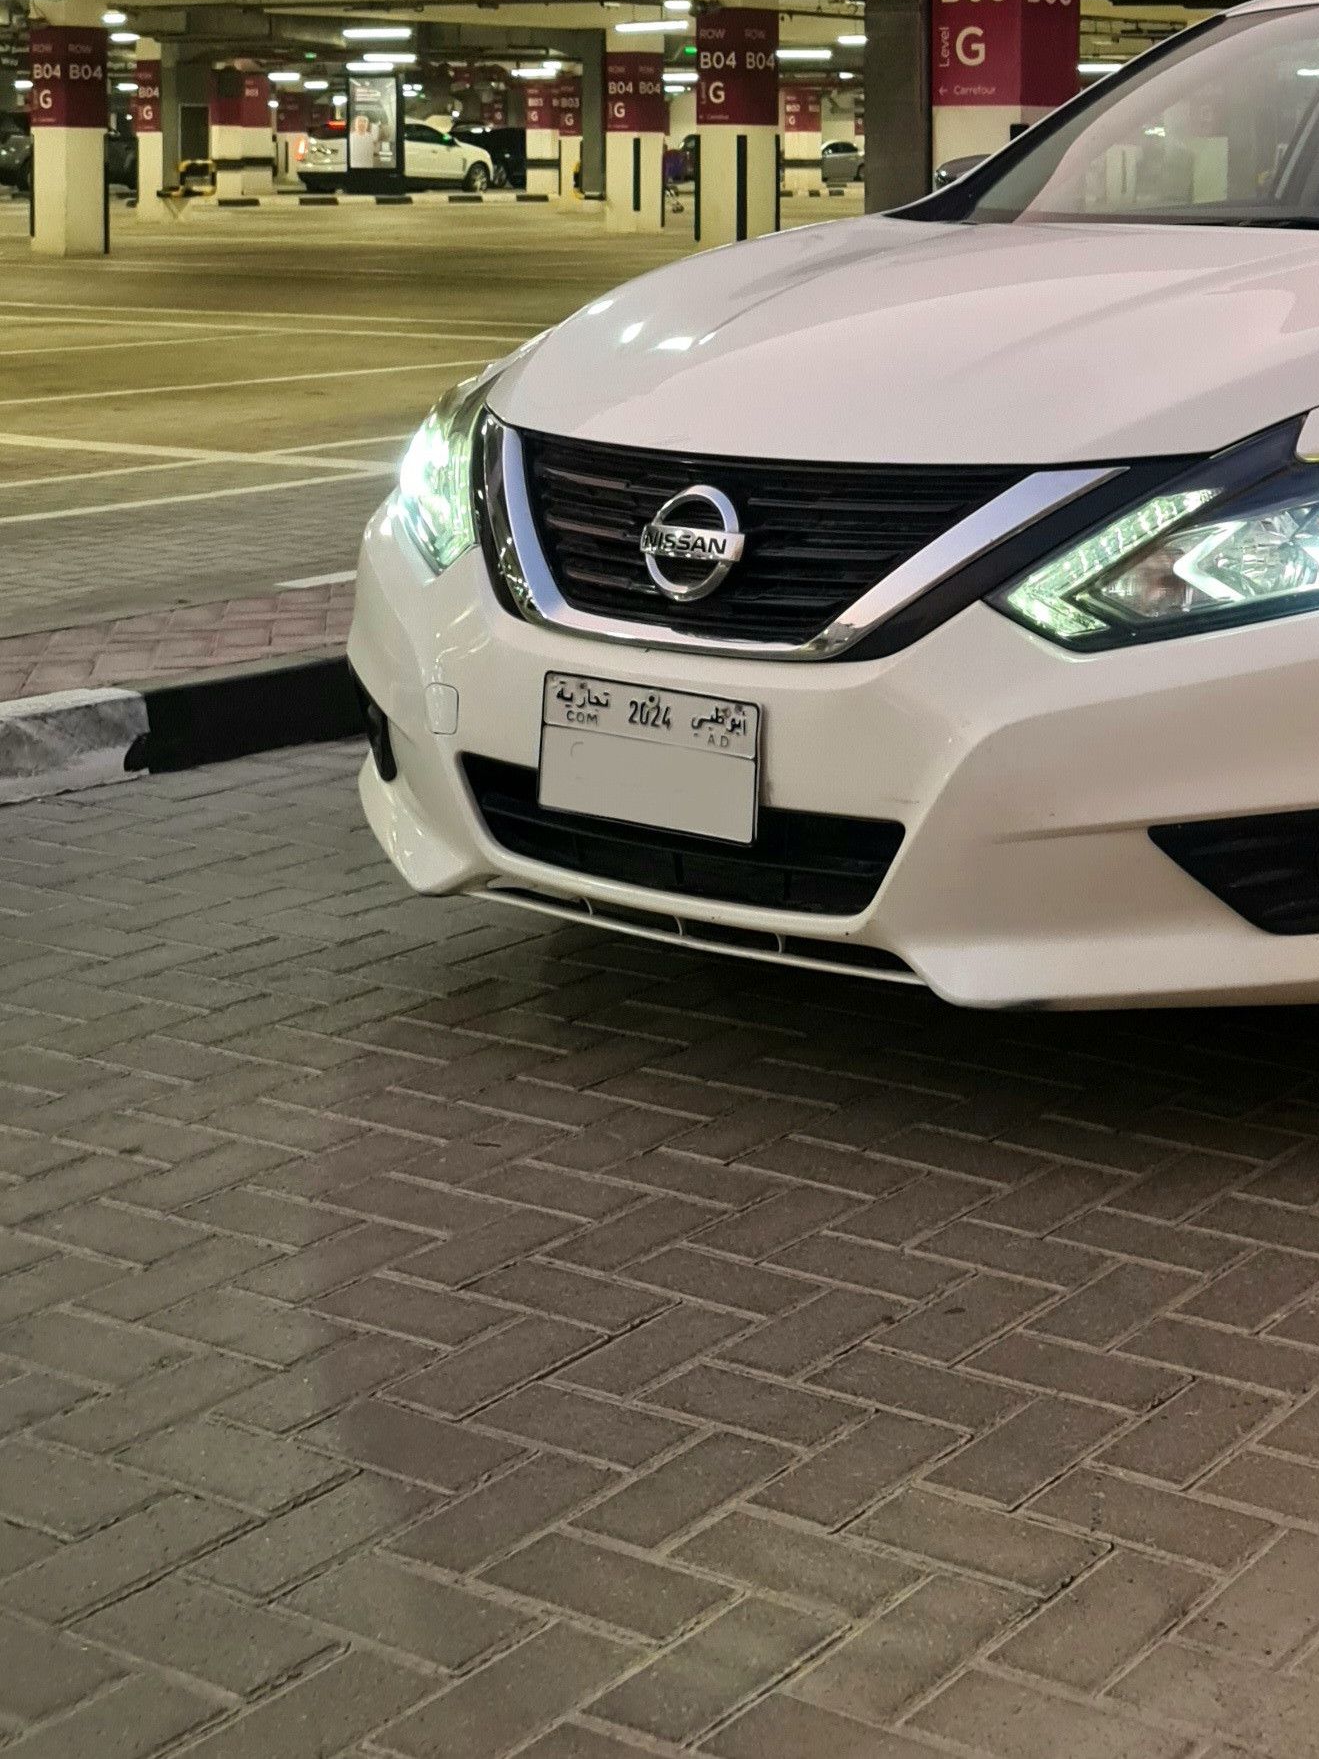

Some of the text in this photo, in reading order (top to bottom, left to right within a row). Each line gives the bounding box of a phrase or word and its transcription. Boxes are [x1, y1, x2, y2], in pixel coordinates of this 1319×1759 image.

[938, 27, 950, 67] Level
[955, 26, 986, 66] G
[700, 51, 737, 70] B04
[745, 51, 776, 70] B04
[33, 63, 61, 79] B04
[69, 64, 103, 80] B04
[138, 87, 160, 98] B04
[608, 81, 633, 94] B04
[639, 81, 661, 94] B04
[709, 81, 726, 104] G
[39, 89, 53, 109] G
[143, 105, 154, 120] G
[614, 101, 626, 118] G
[565, 113, 574, 126] G
[643, 531, 727, 555] NISSAN
[556, 680, 610, 712] تجارية
[566, 709, 598, 725] COM
[628, 700, 671, 730] 2024
